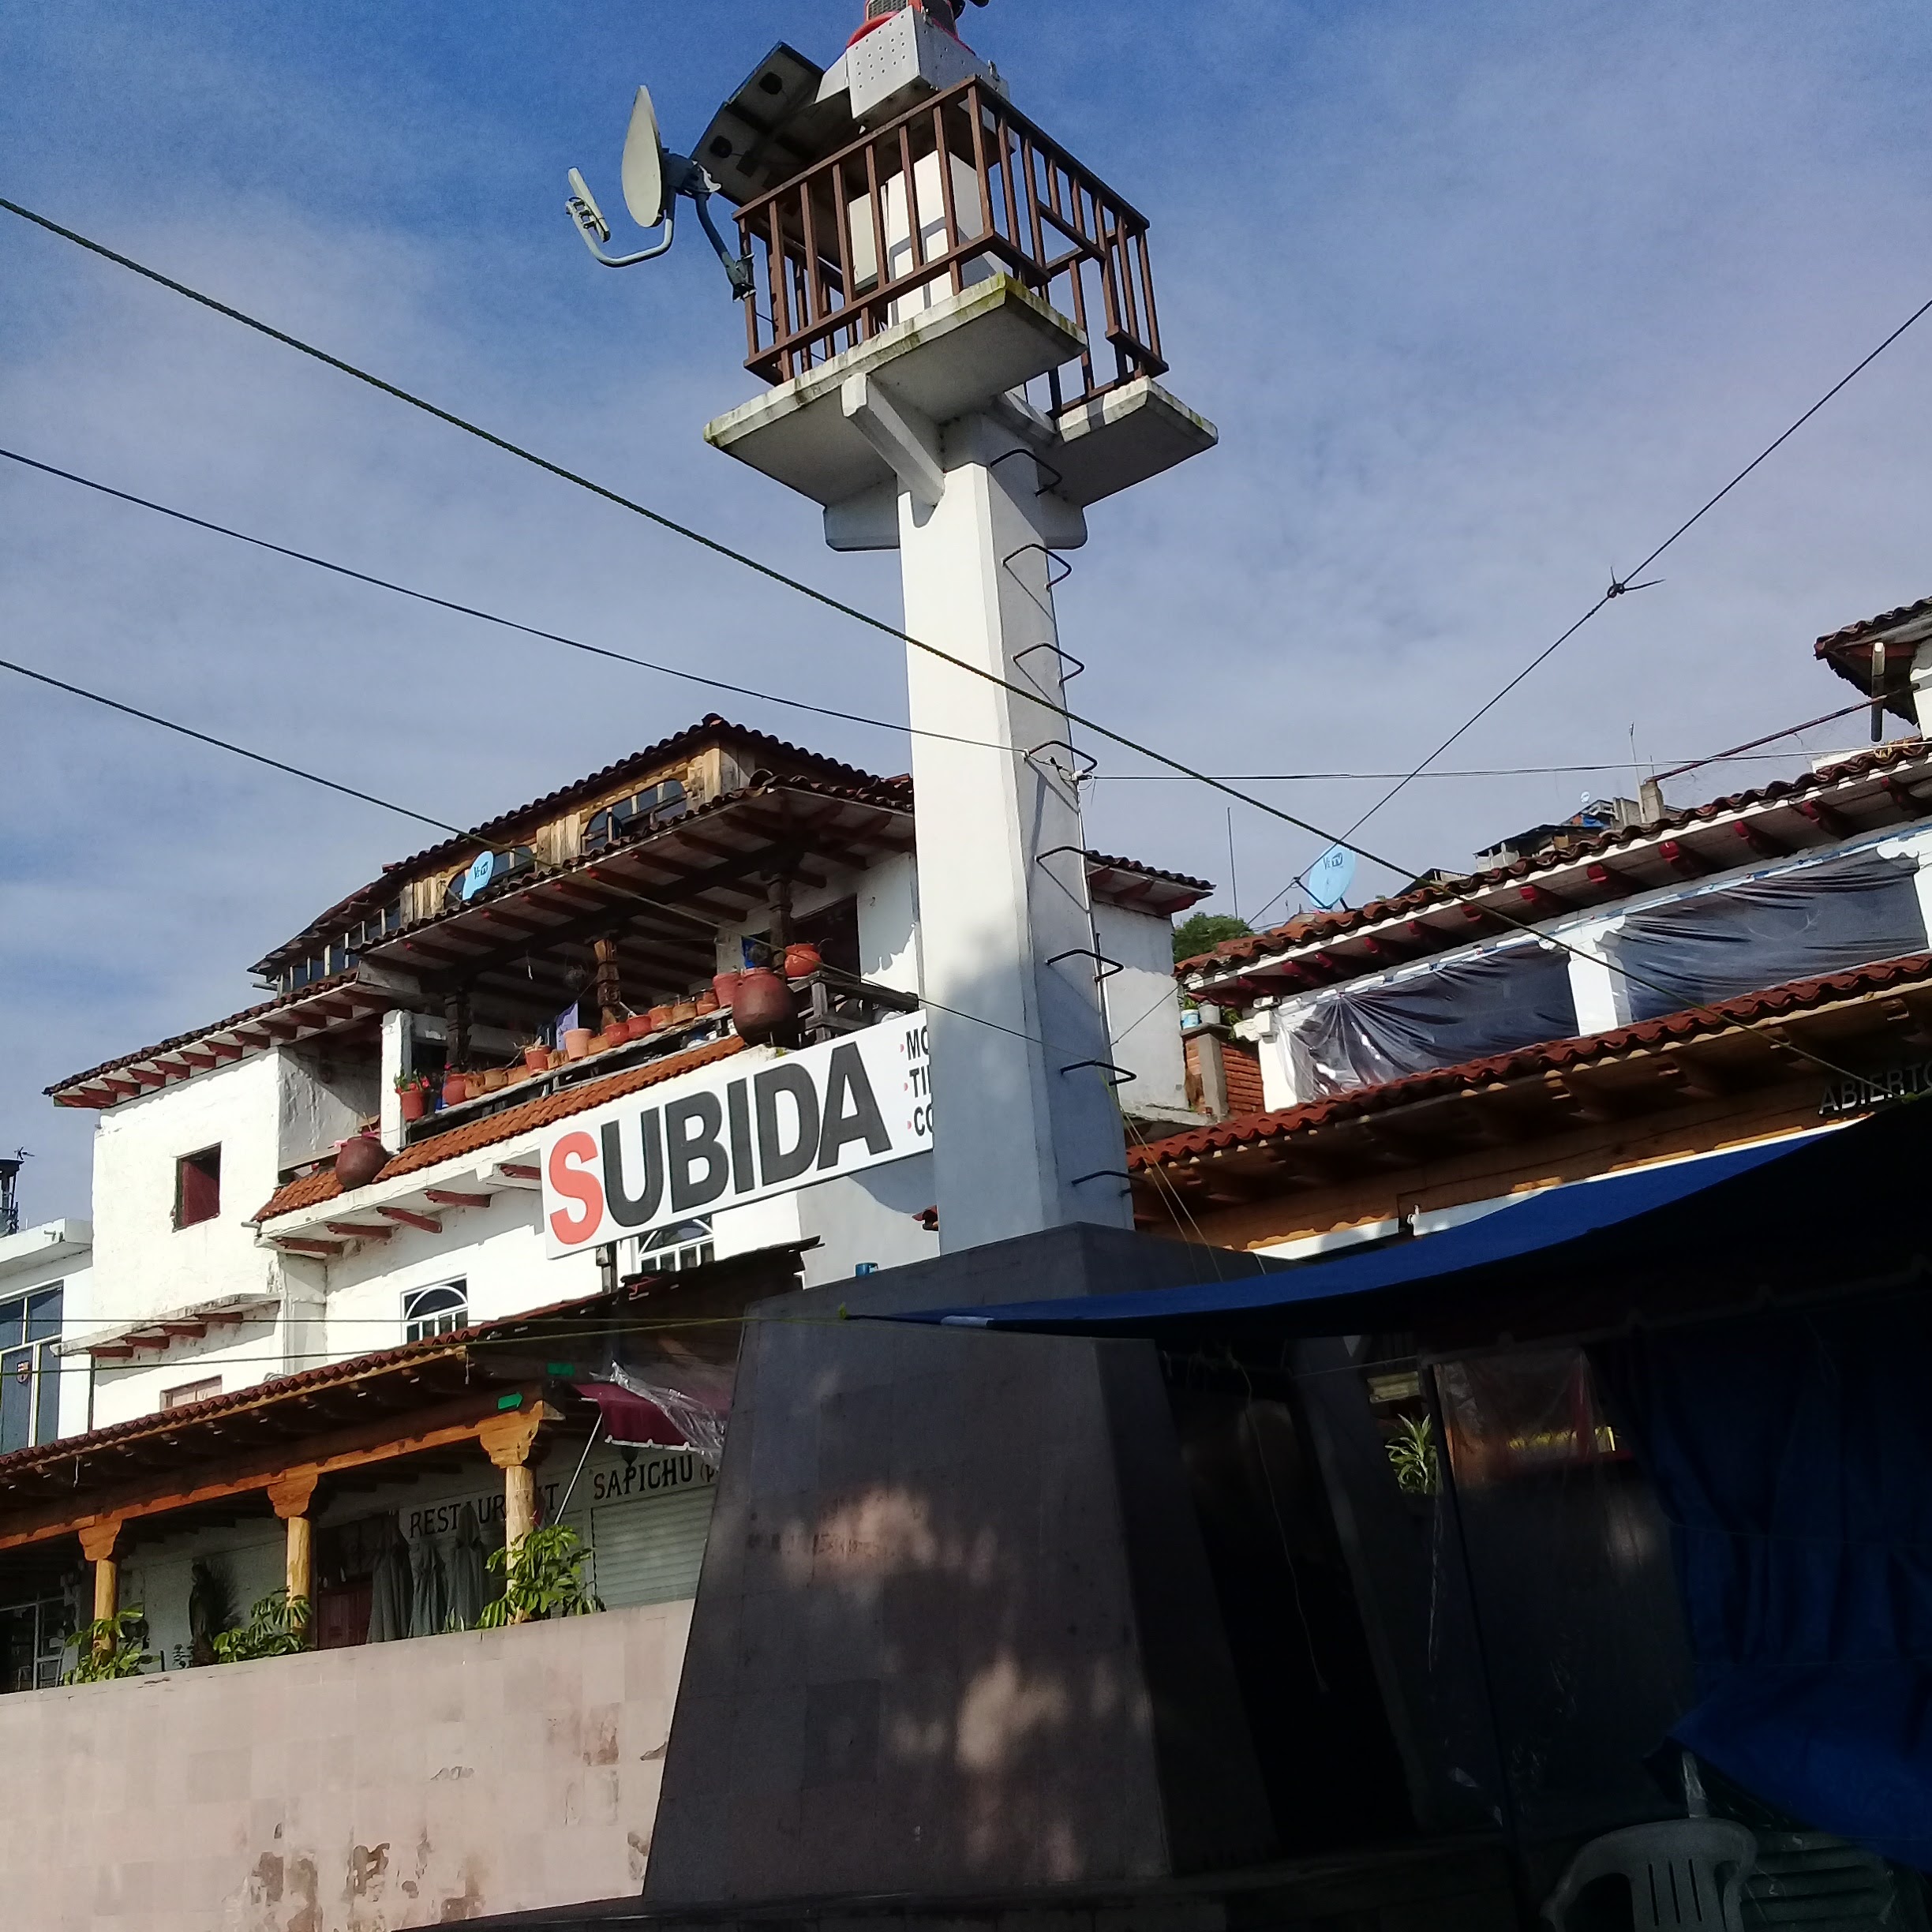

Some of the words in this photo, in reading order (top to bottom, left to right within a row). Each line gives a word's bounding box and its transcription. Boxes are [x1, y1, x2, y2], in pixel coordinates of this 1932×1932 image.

[909, 1065, 932, 1098] TI
[549, 1041, 893, 1245] SUBIDA
[593, 1455, 693, 1500] SAPICHU
[410, 1483, 560, 1538] RESTURT
